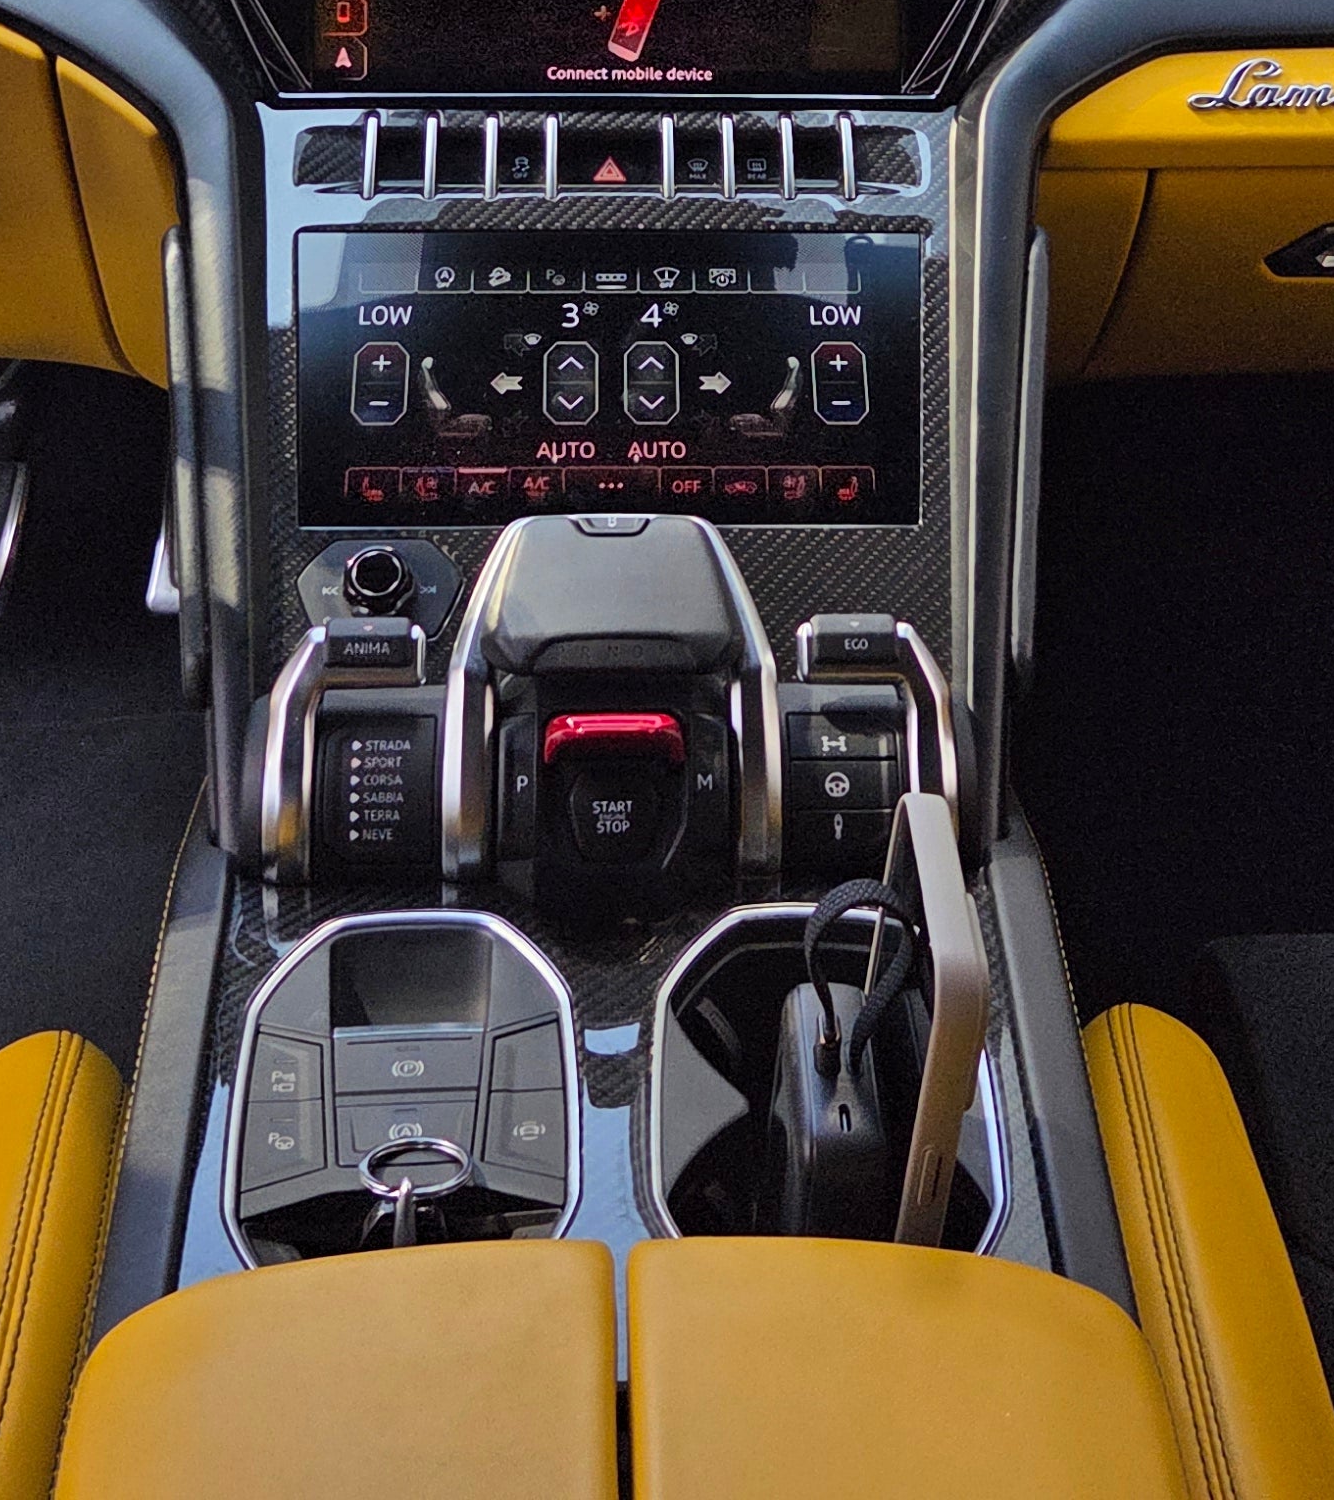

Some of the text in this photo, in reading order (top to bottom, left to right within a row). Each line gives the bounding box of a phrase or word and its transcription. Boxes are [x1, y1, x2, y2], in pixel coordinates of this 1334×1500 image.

[546, 66, 713, 82] Connect mobile device
[513, 171, 528, 179] OFF
[689, 173, 707, 181] MAX
[358, 304, 413, 327] LOW
[561, 302, 580, 328] 3
[639, 302, 663, 328] 4
[809, 304, 862, 326] LOW
[535, 441, 596, 460] AUTO
[627, 441, 687, 460] AUTO
[467, 480, 496, 495] A/C
[523, 476, 551, 490] A/C
[672, 479, 702, 495] OFF
[343, 641, 391, 656] ANIMA
[844, 637, 869, 651] ECO
[364, 739, 411, 752] STRADA
[364, 756, 403, 768] SPORT
[363, 773, 404, 786] CORSA
[517, 775, 529, 793] P
[697, 773, 713, 791] M
[362, 791, 405, 803] SABBIA
[592, 800, 633, 814] START
[363, 809, 401, 822] TERRA
[596, 820, 631, 834] STOP
[363, 828, 394, 841] NEVE
